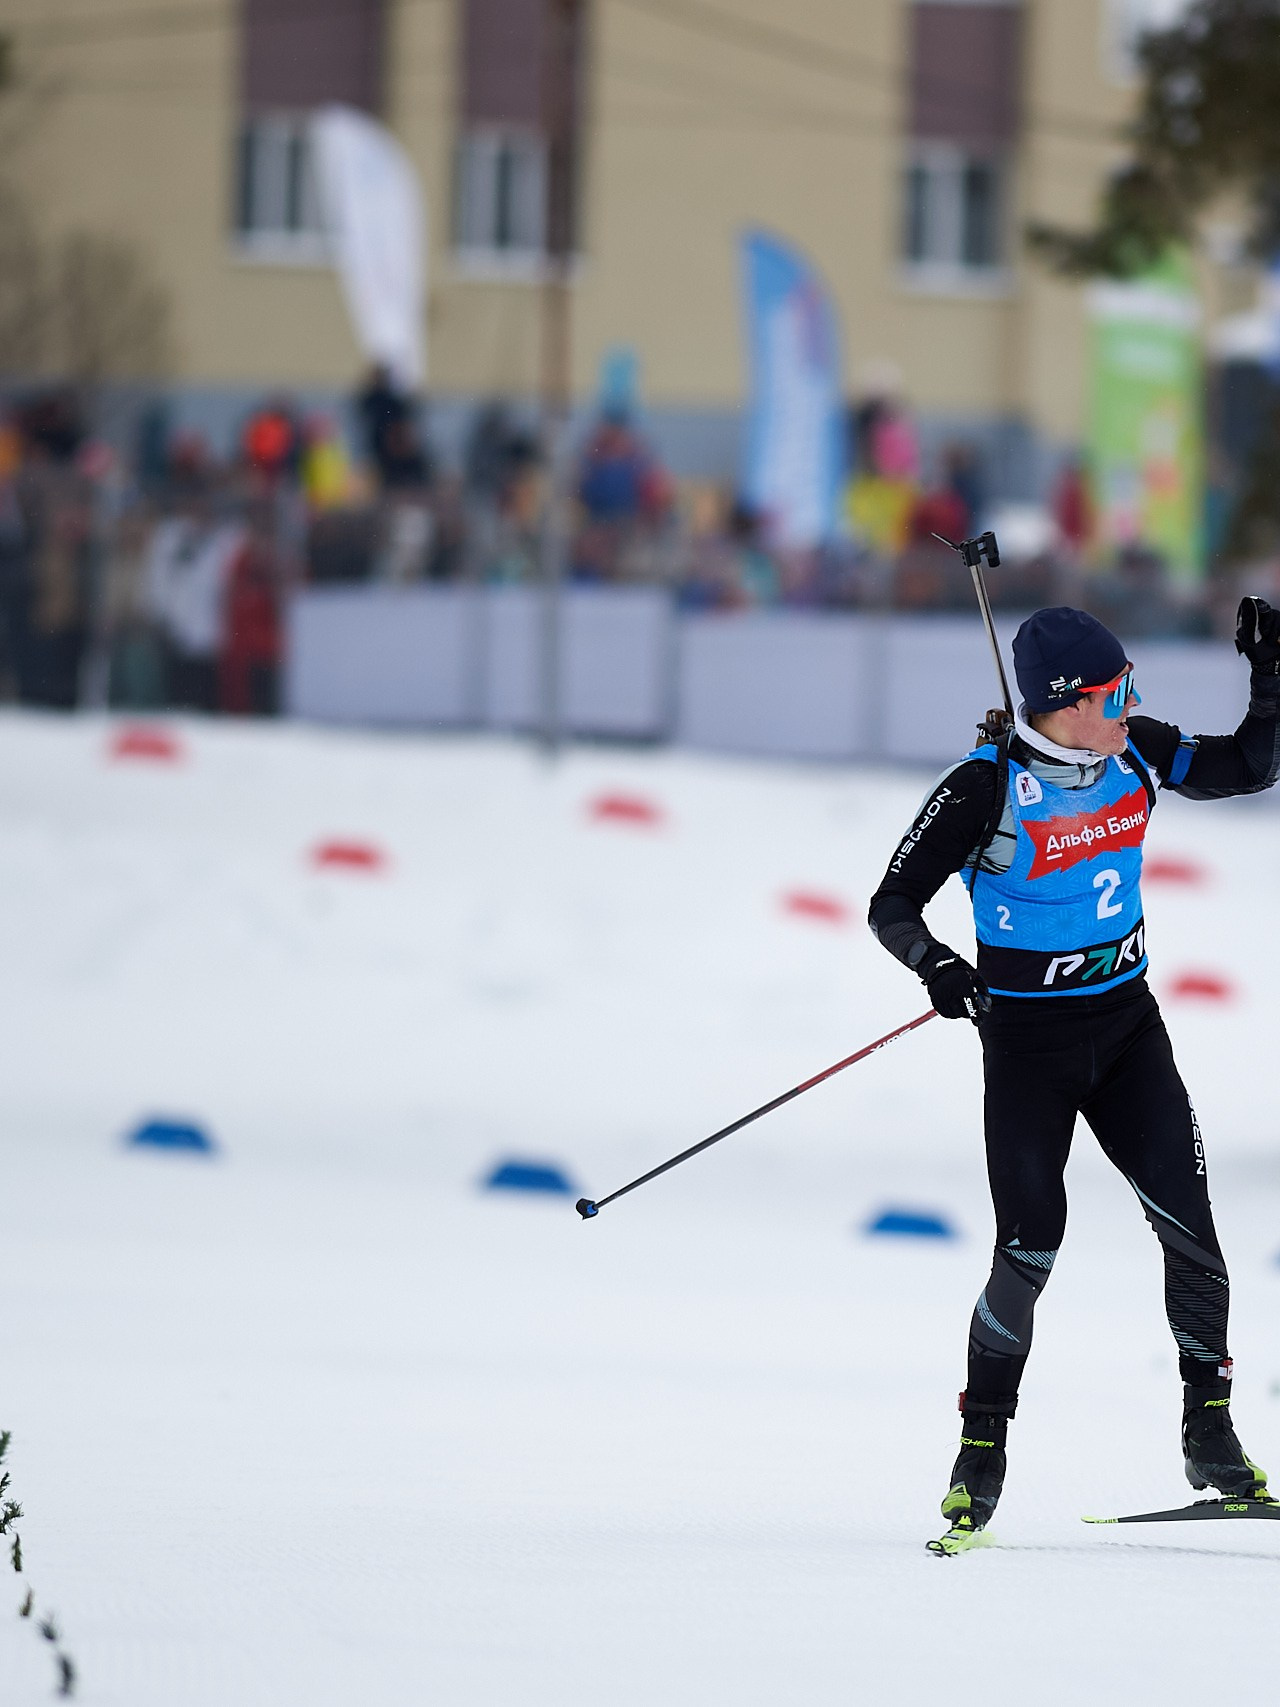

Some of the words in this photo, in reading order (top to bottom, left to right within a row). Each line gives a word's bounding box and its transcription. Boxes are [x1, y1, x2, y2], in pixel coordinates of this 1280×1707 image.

[890, 787, 952, 873] NORDSKI
[1046, 826, 1106, 857] Альфа
[1107, 810, 1146, 835] Банк
[1092, 868, 1123, 920] 2
[996, 905, 1014, 931] 2
[1224, 1503, 1249, 1512] FISCHER
